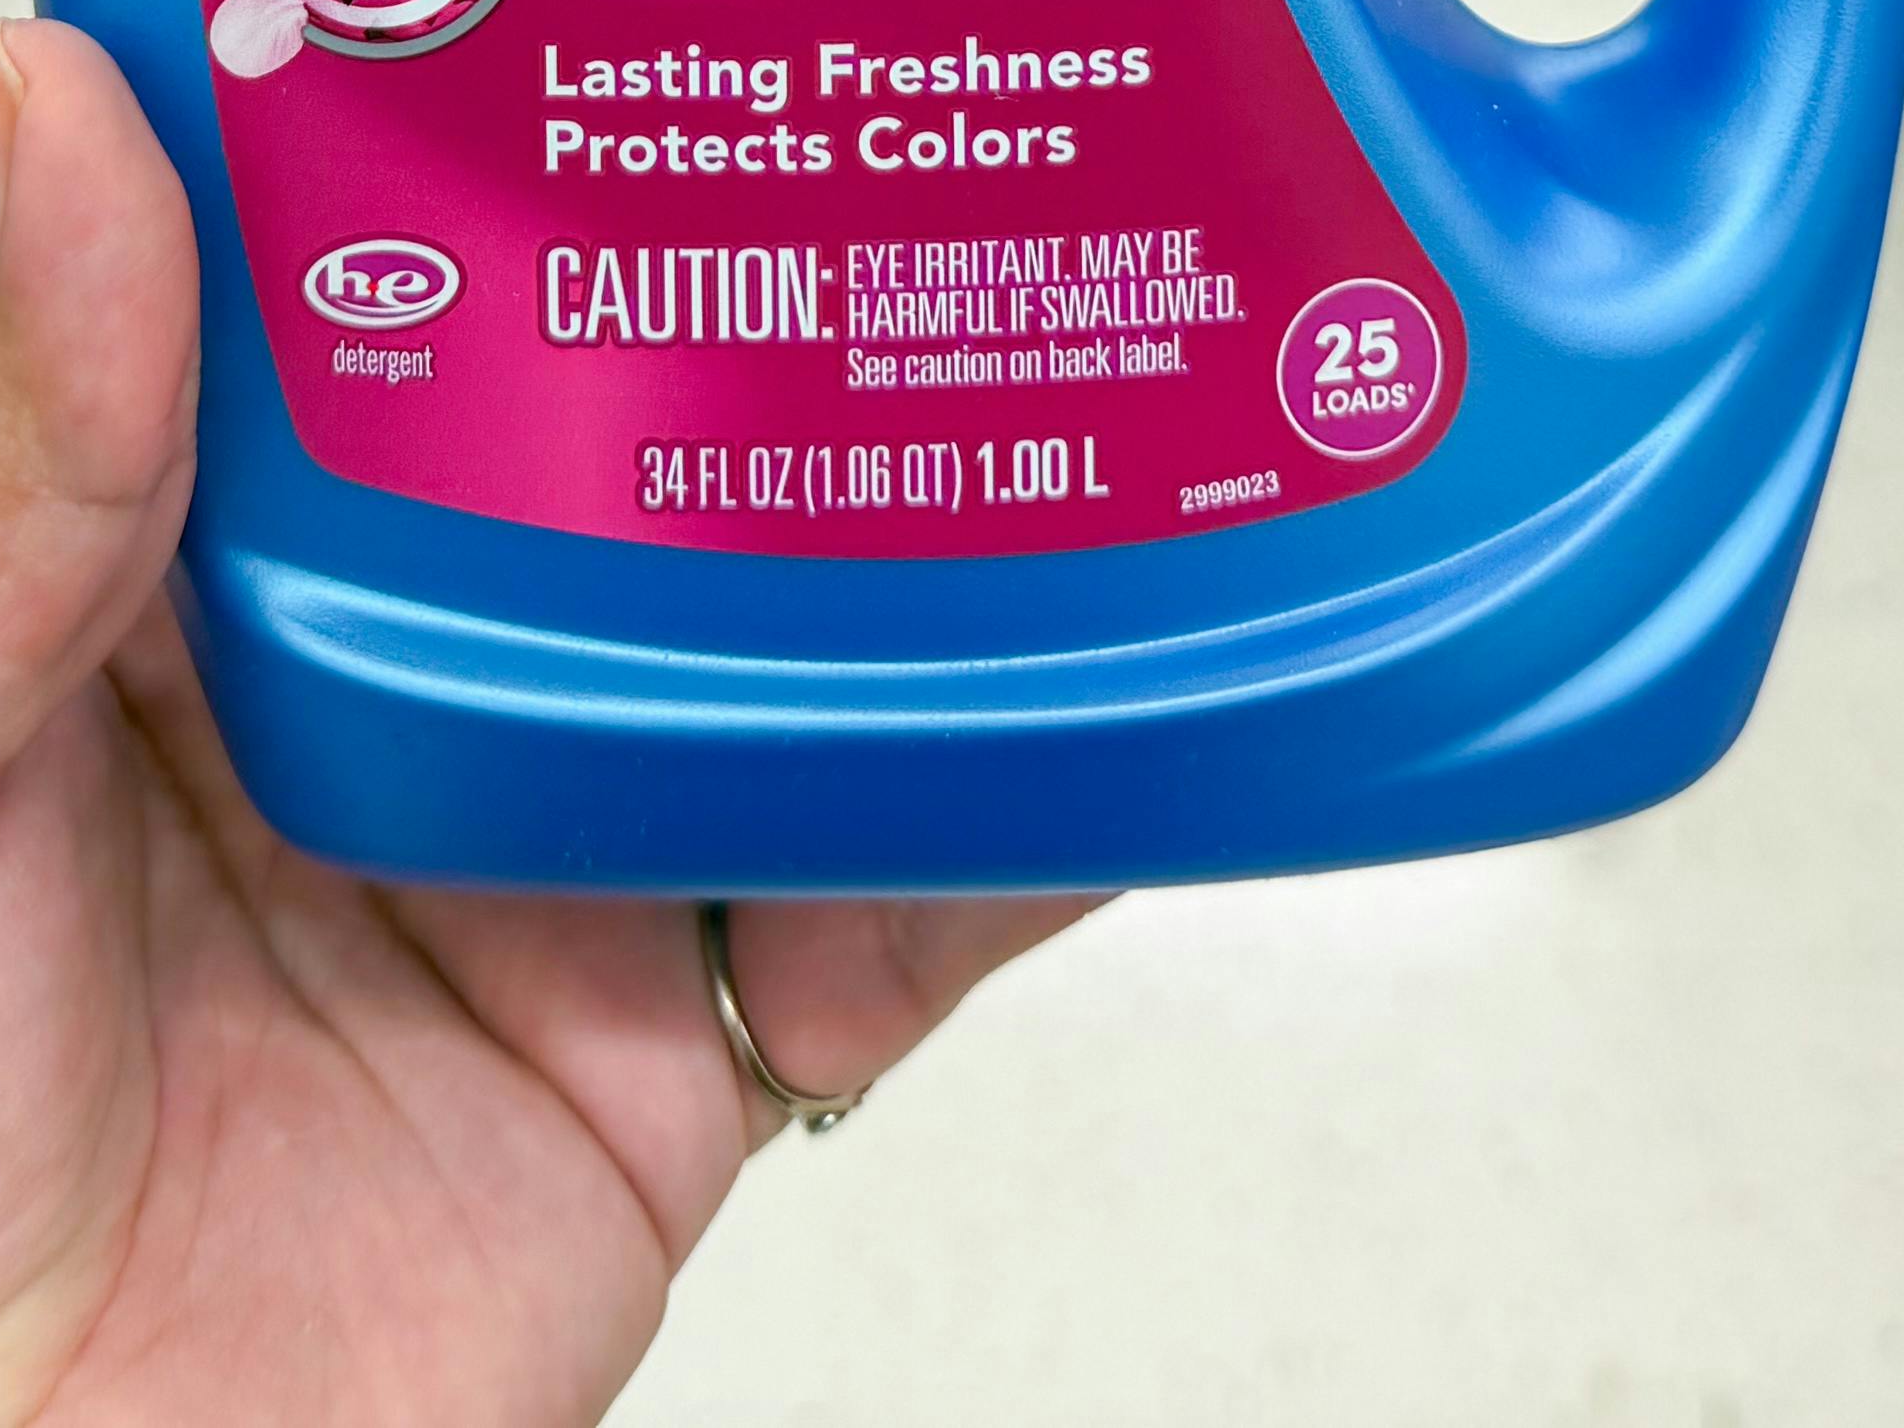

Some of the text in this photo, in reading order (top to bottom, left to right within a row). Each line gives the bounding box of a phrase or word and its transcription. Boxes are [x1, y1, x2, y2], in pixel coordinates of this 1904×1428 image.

[545, 36, 1151, 113] Lasting Freshness
[545, 111, 1076, 173] Protects Colors
[847, 228, 1200, 289] EYE IRRITANT. MAY BE
[547, 246, 834, 341] CAUTION:
[847, 274, 1246, 340] HARMFUL IF SWALLOWED.
[332, 339, 434, 384] detergent
[847, 332, 1189, 389] See caution on back label.
[1314, 318, 1399, 383] 25
[643, 436, 1109, 516] 34 FL OZ (1.06 QT) 1.00 L
[1179, 470, 1280, 511] 2999023
